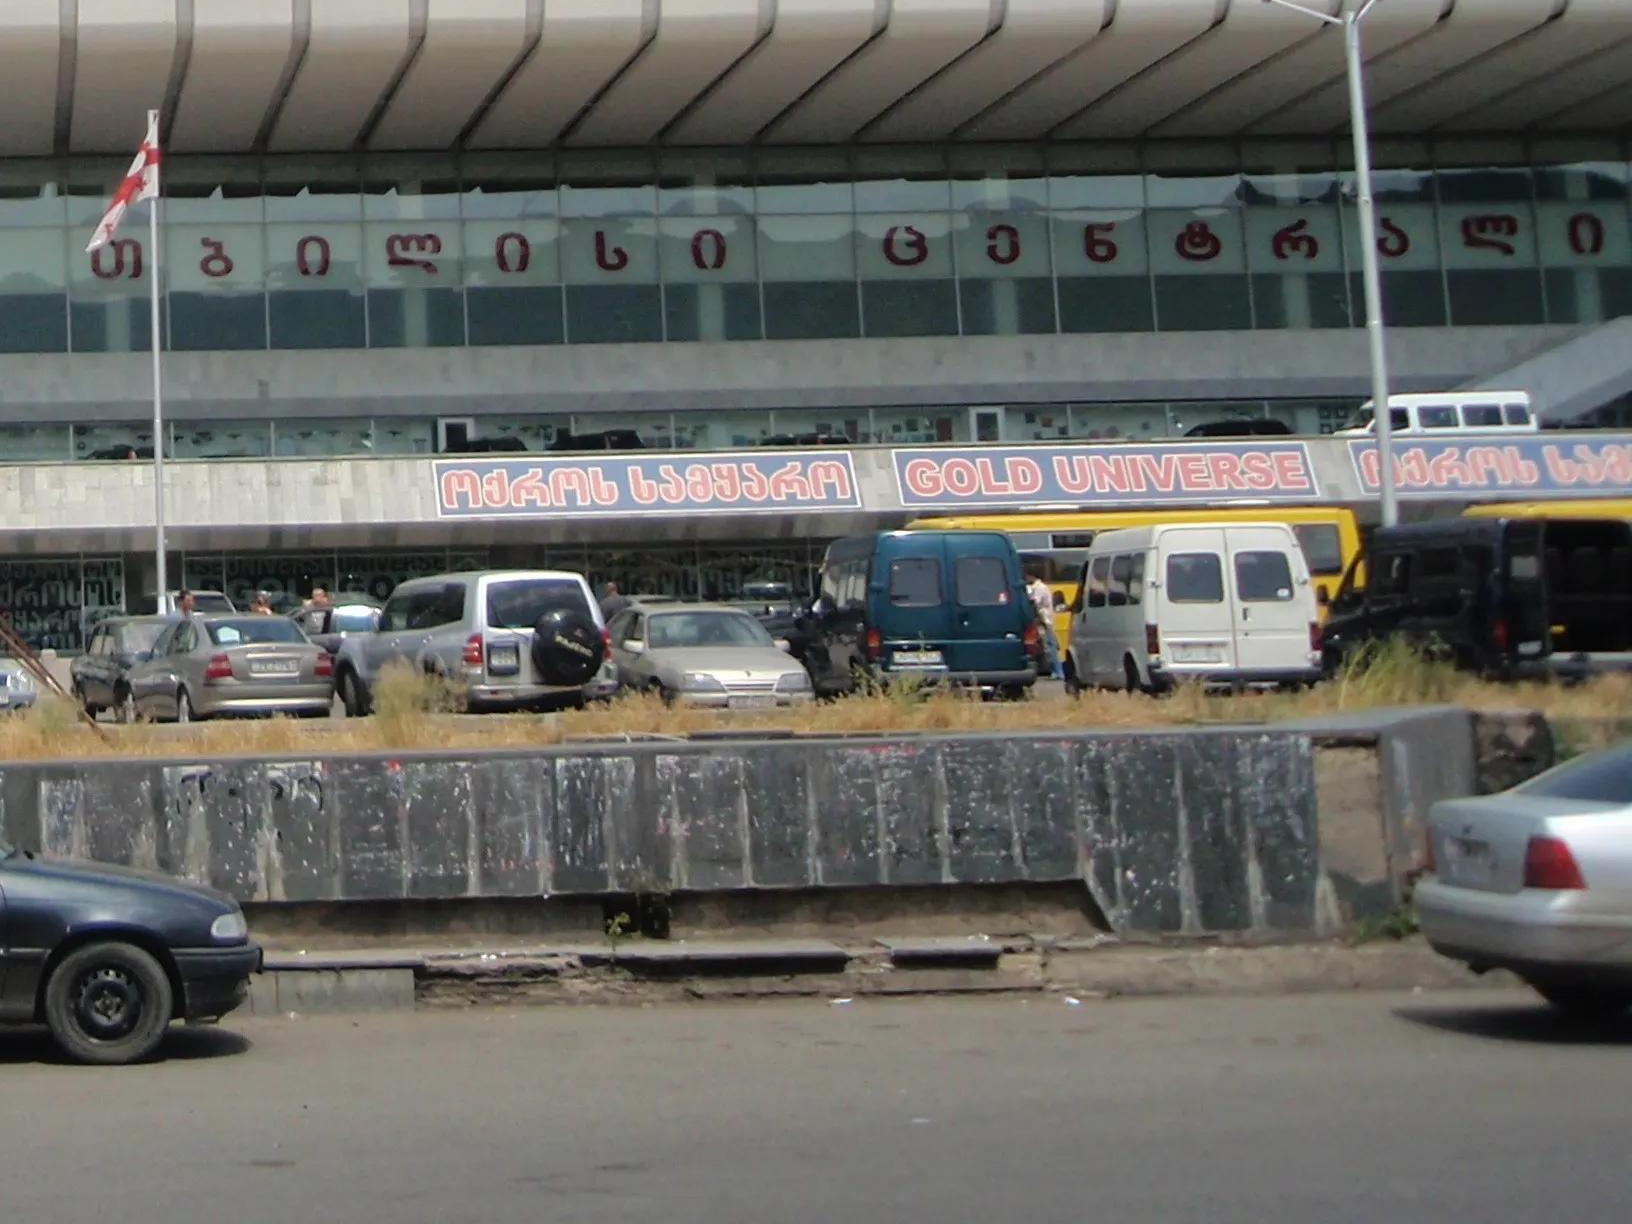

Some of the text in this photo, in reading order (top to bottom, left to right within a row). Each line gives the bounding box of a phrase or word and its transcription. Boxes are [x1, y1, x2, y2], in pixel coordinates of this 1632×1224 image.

[90, 212, 1605, 280] თბილისი ცენტრალი
[443, 460, 853, 509] ოქროს სამყარო
[905, 450, 1311, 497] GOLD UNIVERSE
[1541, 443, 1632, 485] სამ
